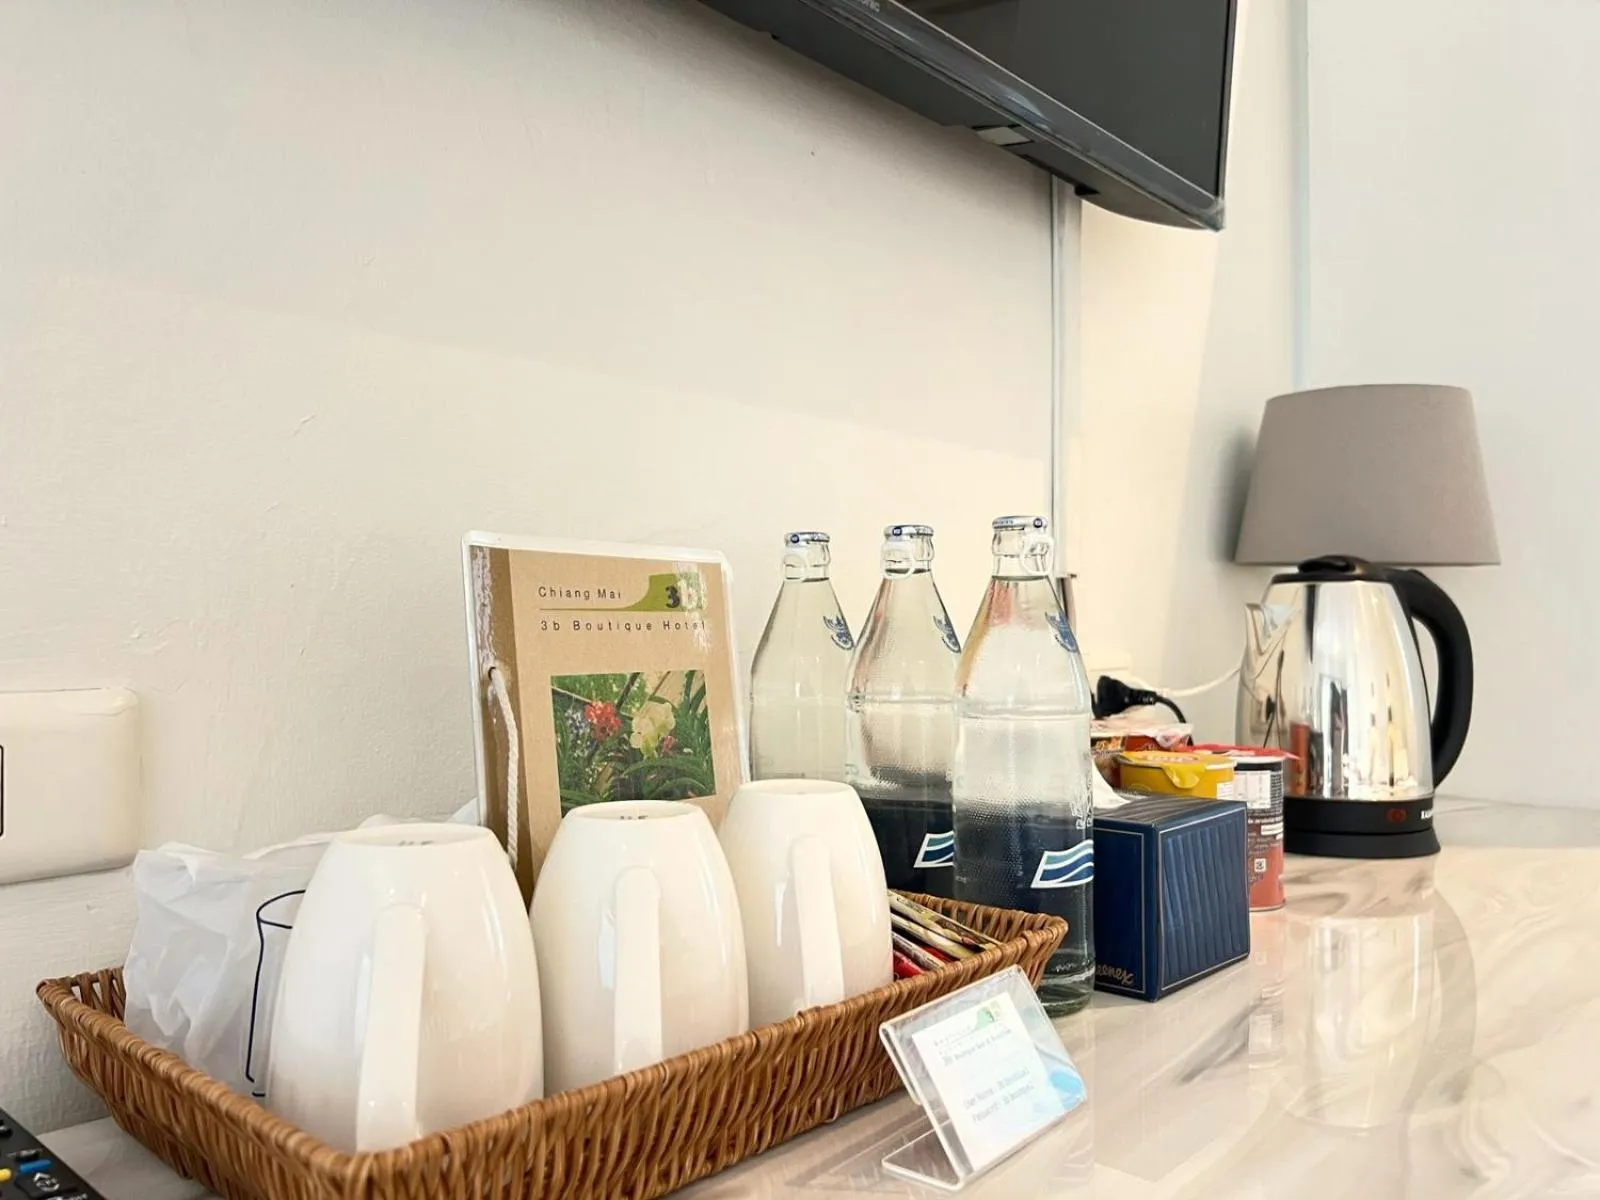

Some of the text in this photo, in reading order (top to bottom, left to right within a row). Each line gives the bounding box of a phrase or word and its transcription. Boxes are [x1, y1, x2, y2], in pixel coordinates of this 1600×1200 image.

[538, 586, 621, 600] Chiang Mai
[541, 620, 706, 632] 3b Boutique Hotel
